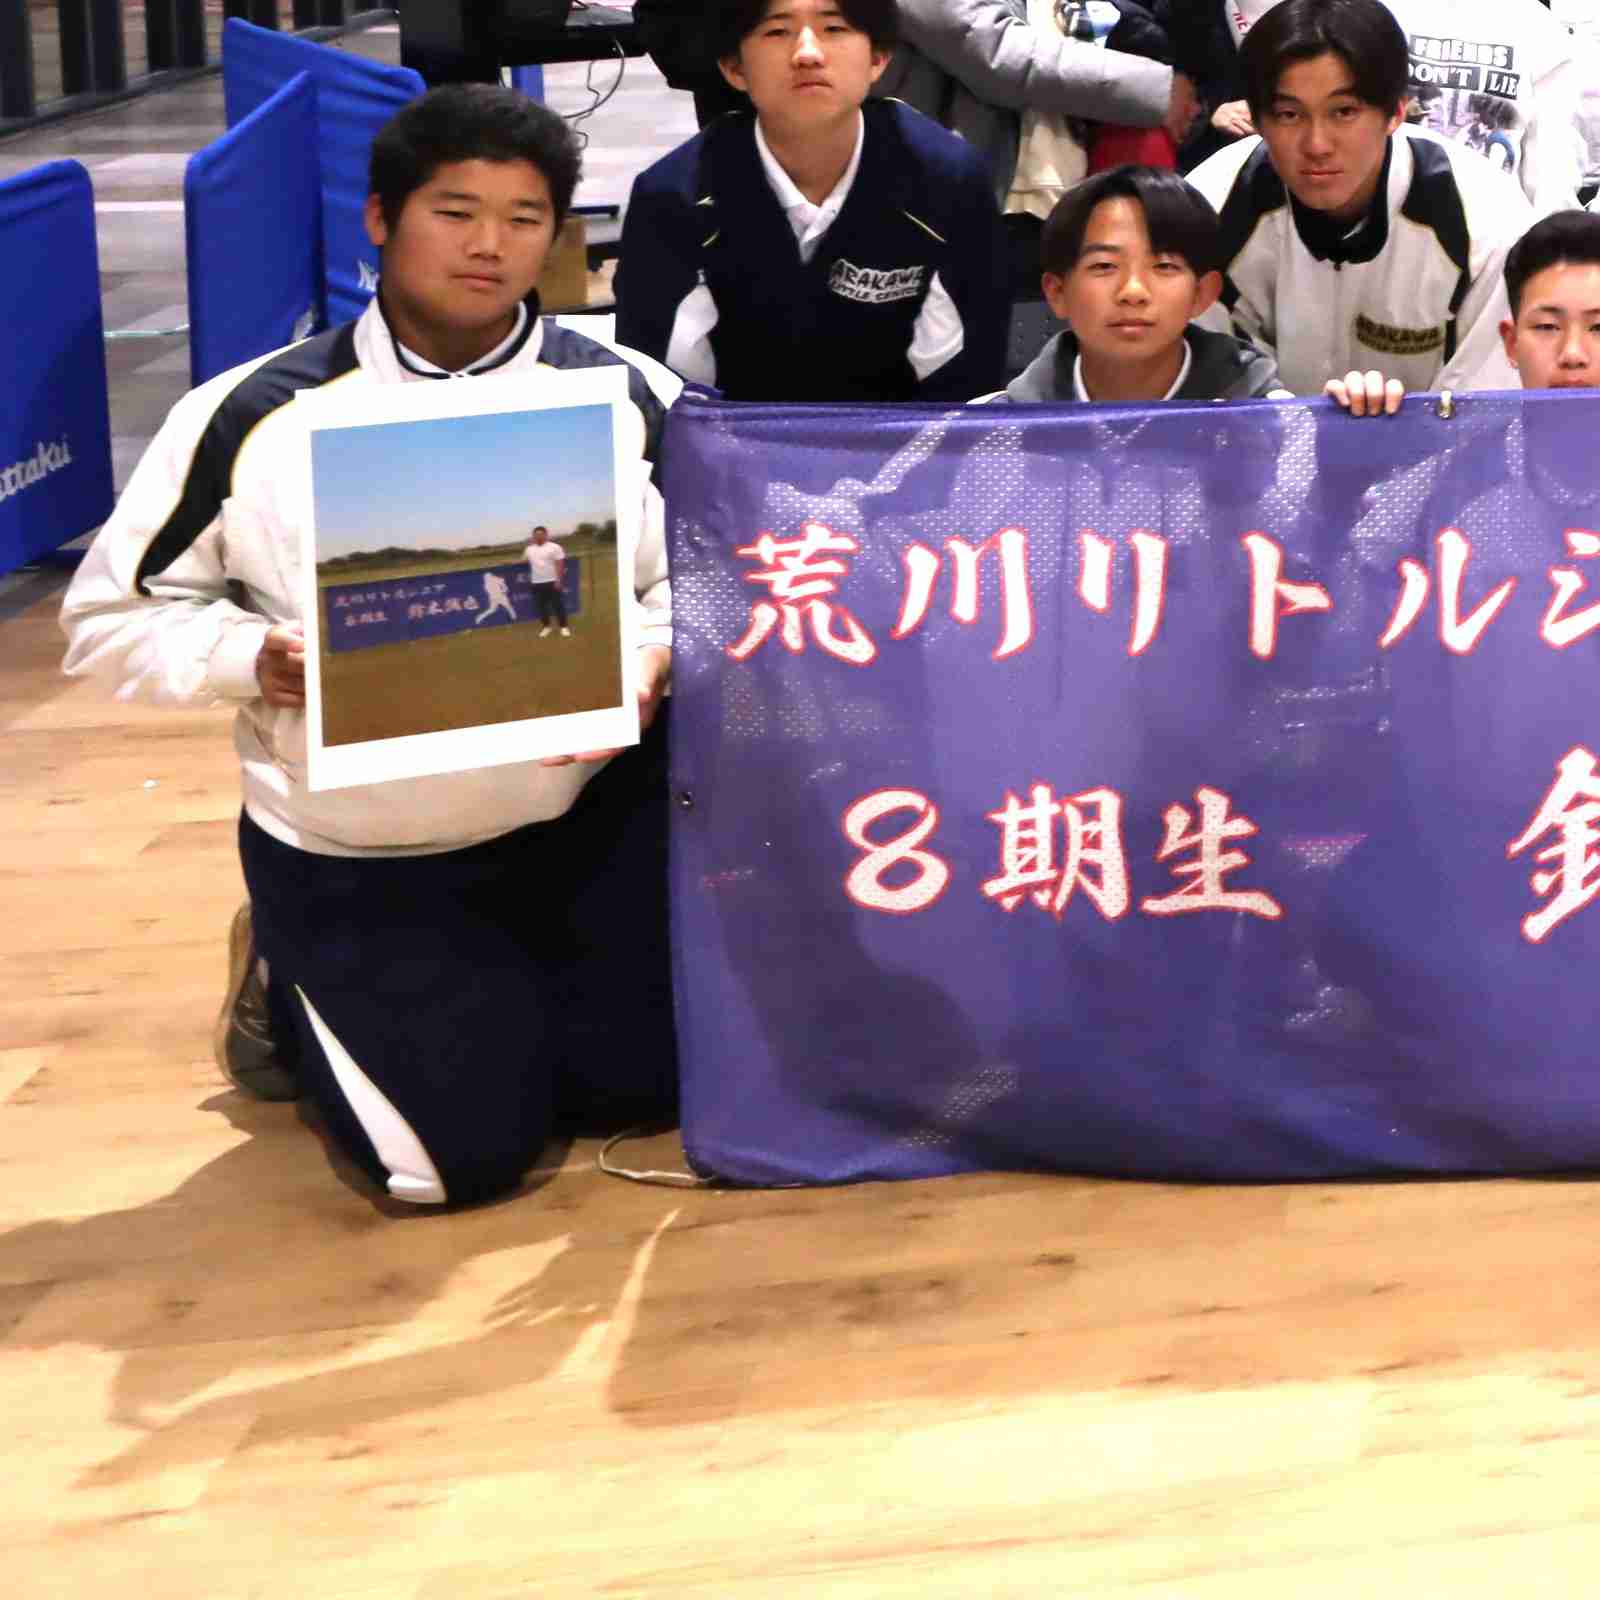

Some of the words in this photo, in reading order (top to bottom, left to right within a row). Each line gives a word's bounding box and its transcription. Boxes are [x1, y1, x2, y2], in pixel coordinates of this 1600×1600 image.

[1414, 37, 1510, 67] FRIENDS
[1488, 70, 1521, 97] LIE
[842, 784, 1284, 923] 8期生
